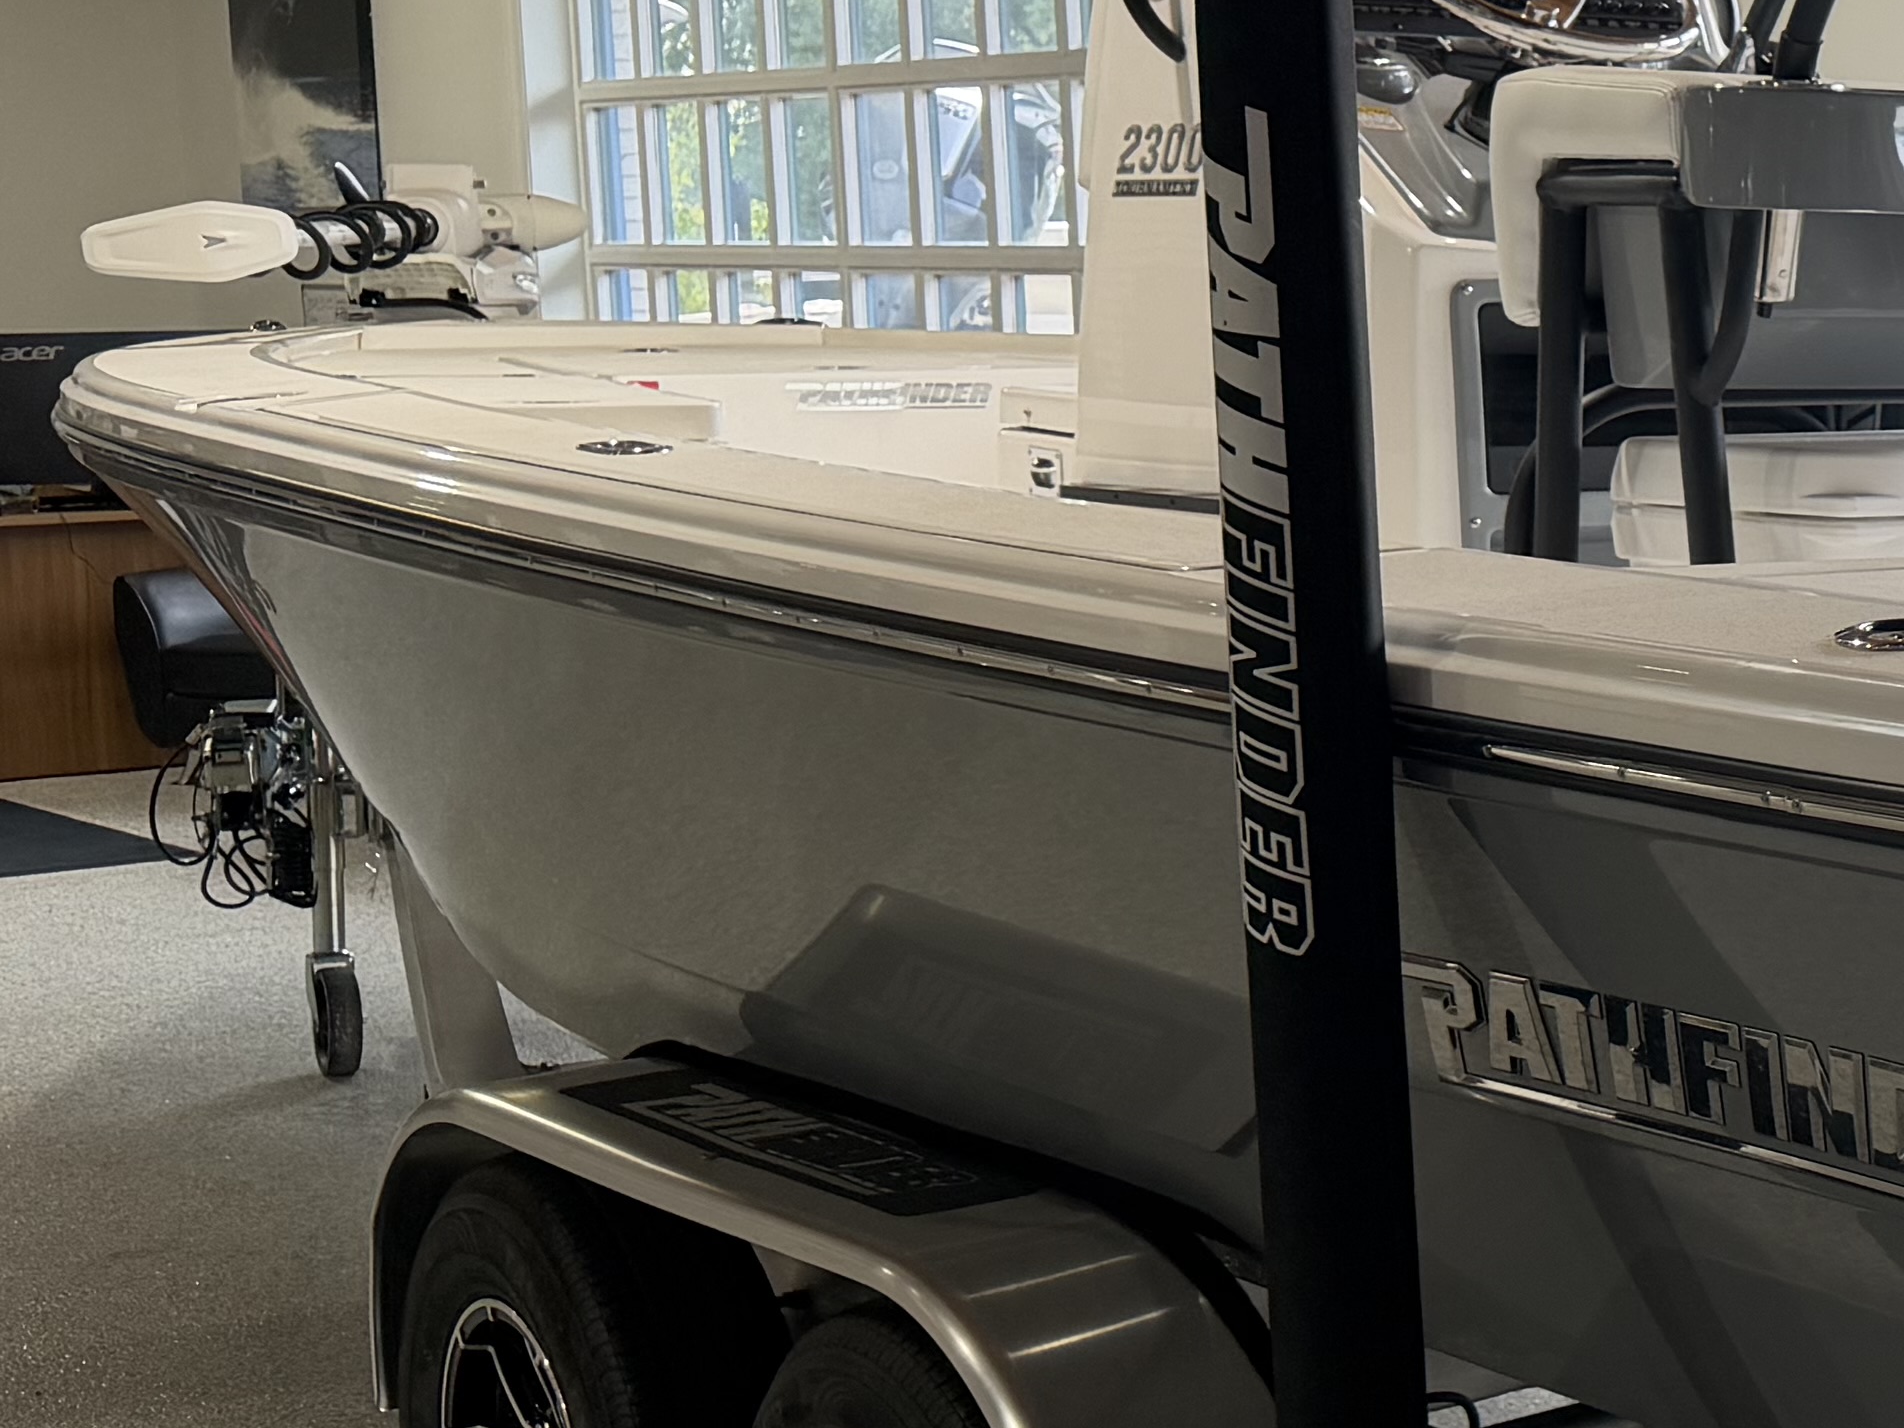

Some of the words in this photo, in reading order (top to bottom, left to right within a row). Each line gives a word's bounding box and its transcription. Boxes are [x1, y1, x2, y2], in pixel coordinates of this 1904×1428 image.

[1116, 123, 1203, 174] 2300
[0, 345, 65, 362] acer
[784, 381, 993, 409] PATHFINDER
[1203, 104, 1318, 959] PATHFINDER
